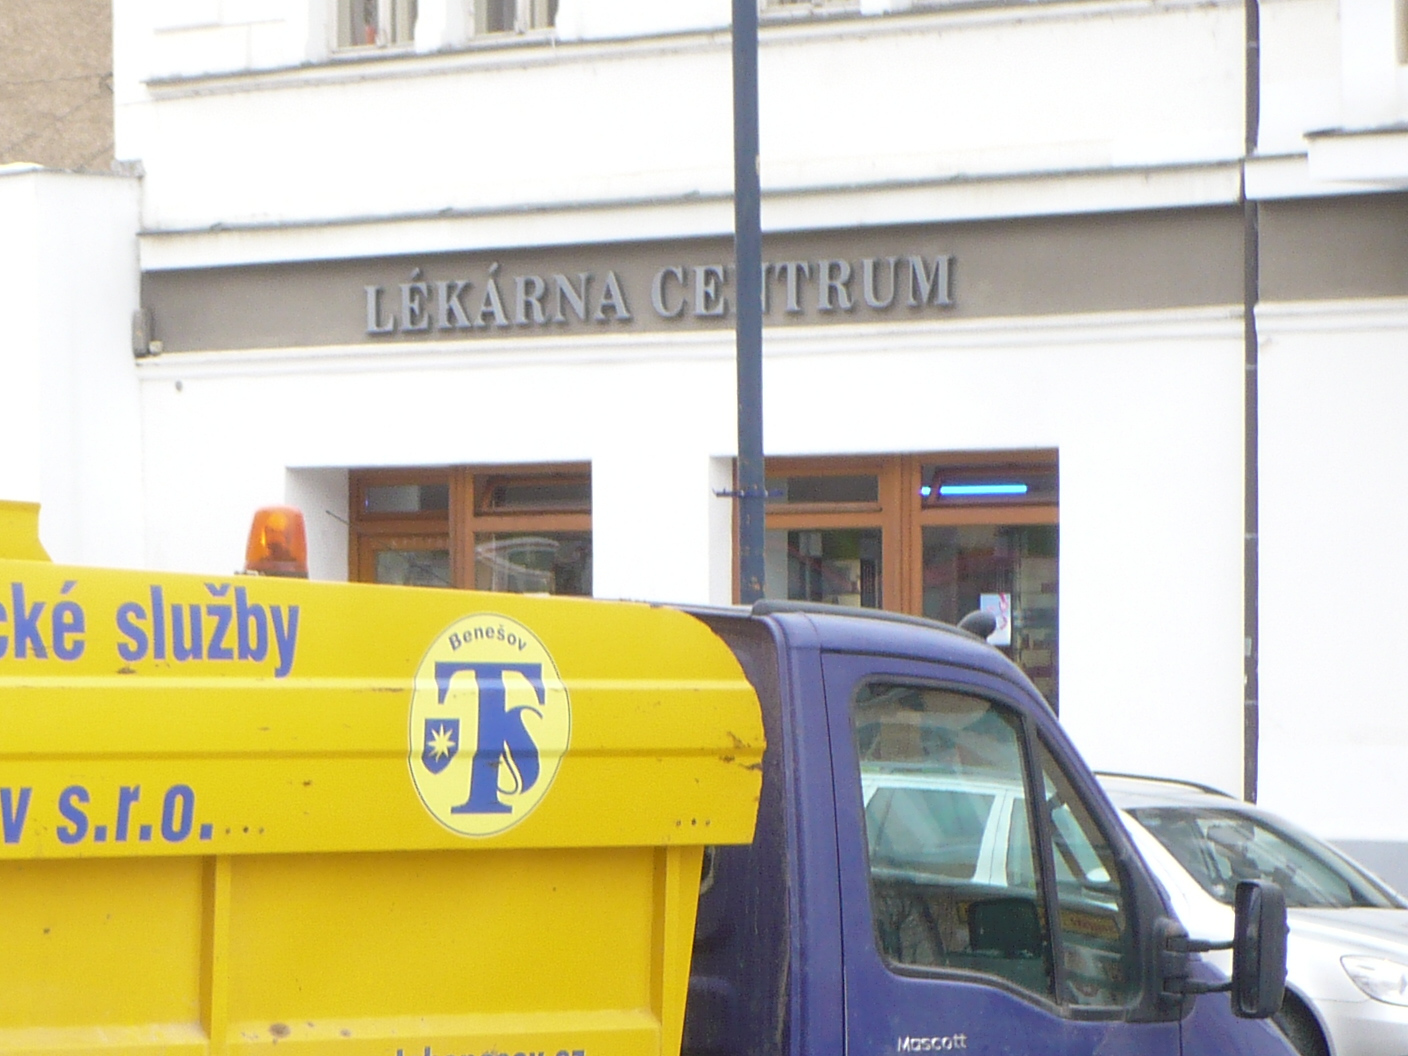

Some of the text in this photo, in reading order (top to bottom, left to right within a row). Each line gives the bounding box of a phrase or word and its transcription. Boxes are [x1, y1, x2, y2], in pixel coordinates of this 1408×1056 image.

[364, 262, 632, 337] LÉKÁRNA
[115, 583, 301, 679] služby
[448, 624, 528, 652] Benešov
[56, 783, 215, 846] s.r.o.
[898, 1033, 967, 1052] Mascott
